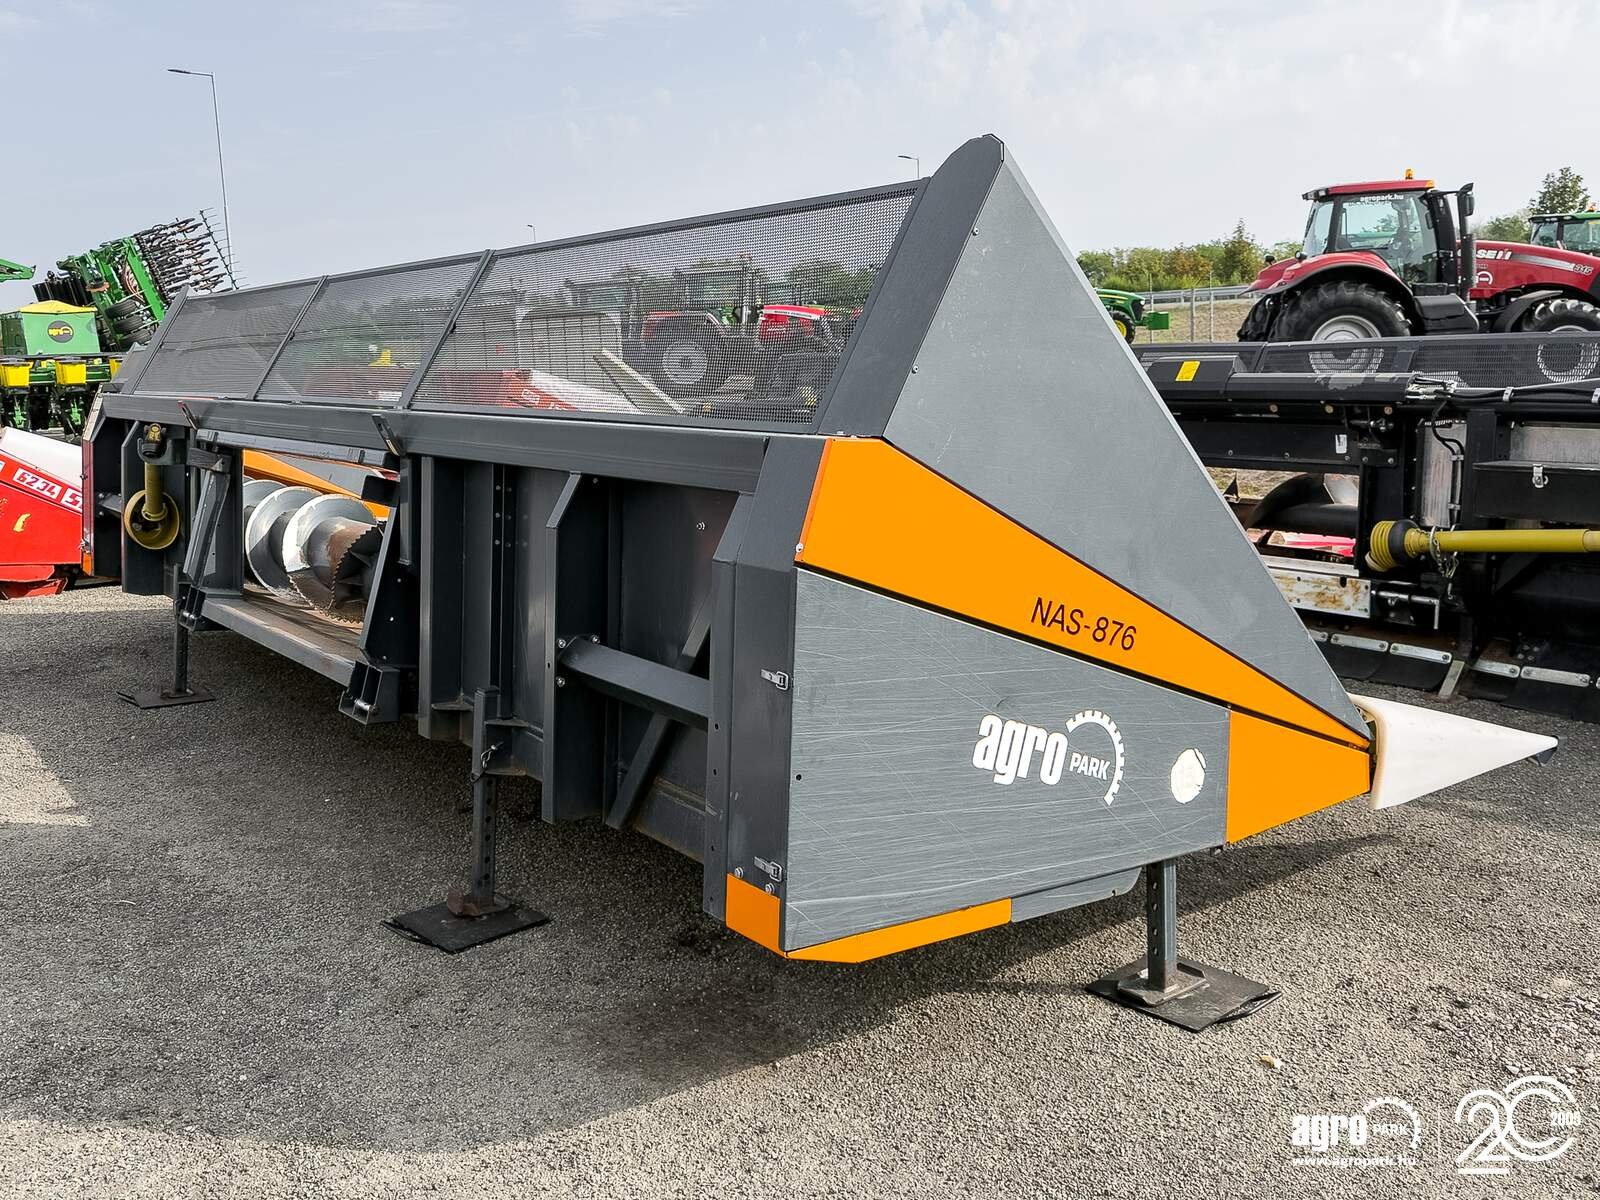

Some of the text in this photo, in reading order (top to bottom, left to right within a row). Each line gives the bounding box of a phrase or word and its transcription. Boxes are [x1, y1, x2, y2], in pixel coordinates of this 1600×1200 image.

[1030, 597, 1137, 651] NAS-876
[972, 714, 1111, 785] agro PARK
